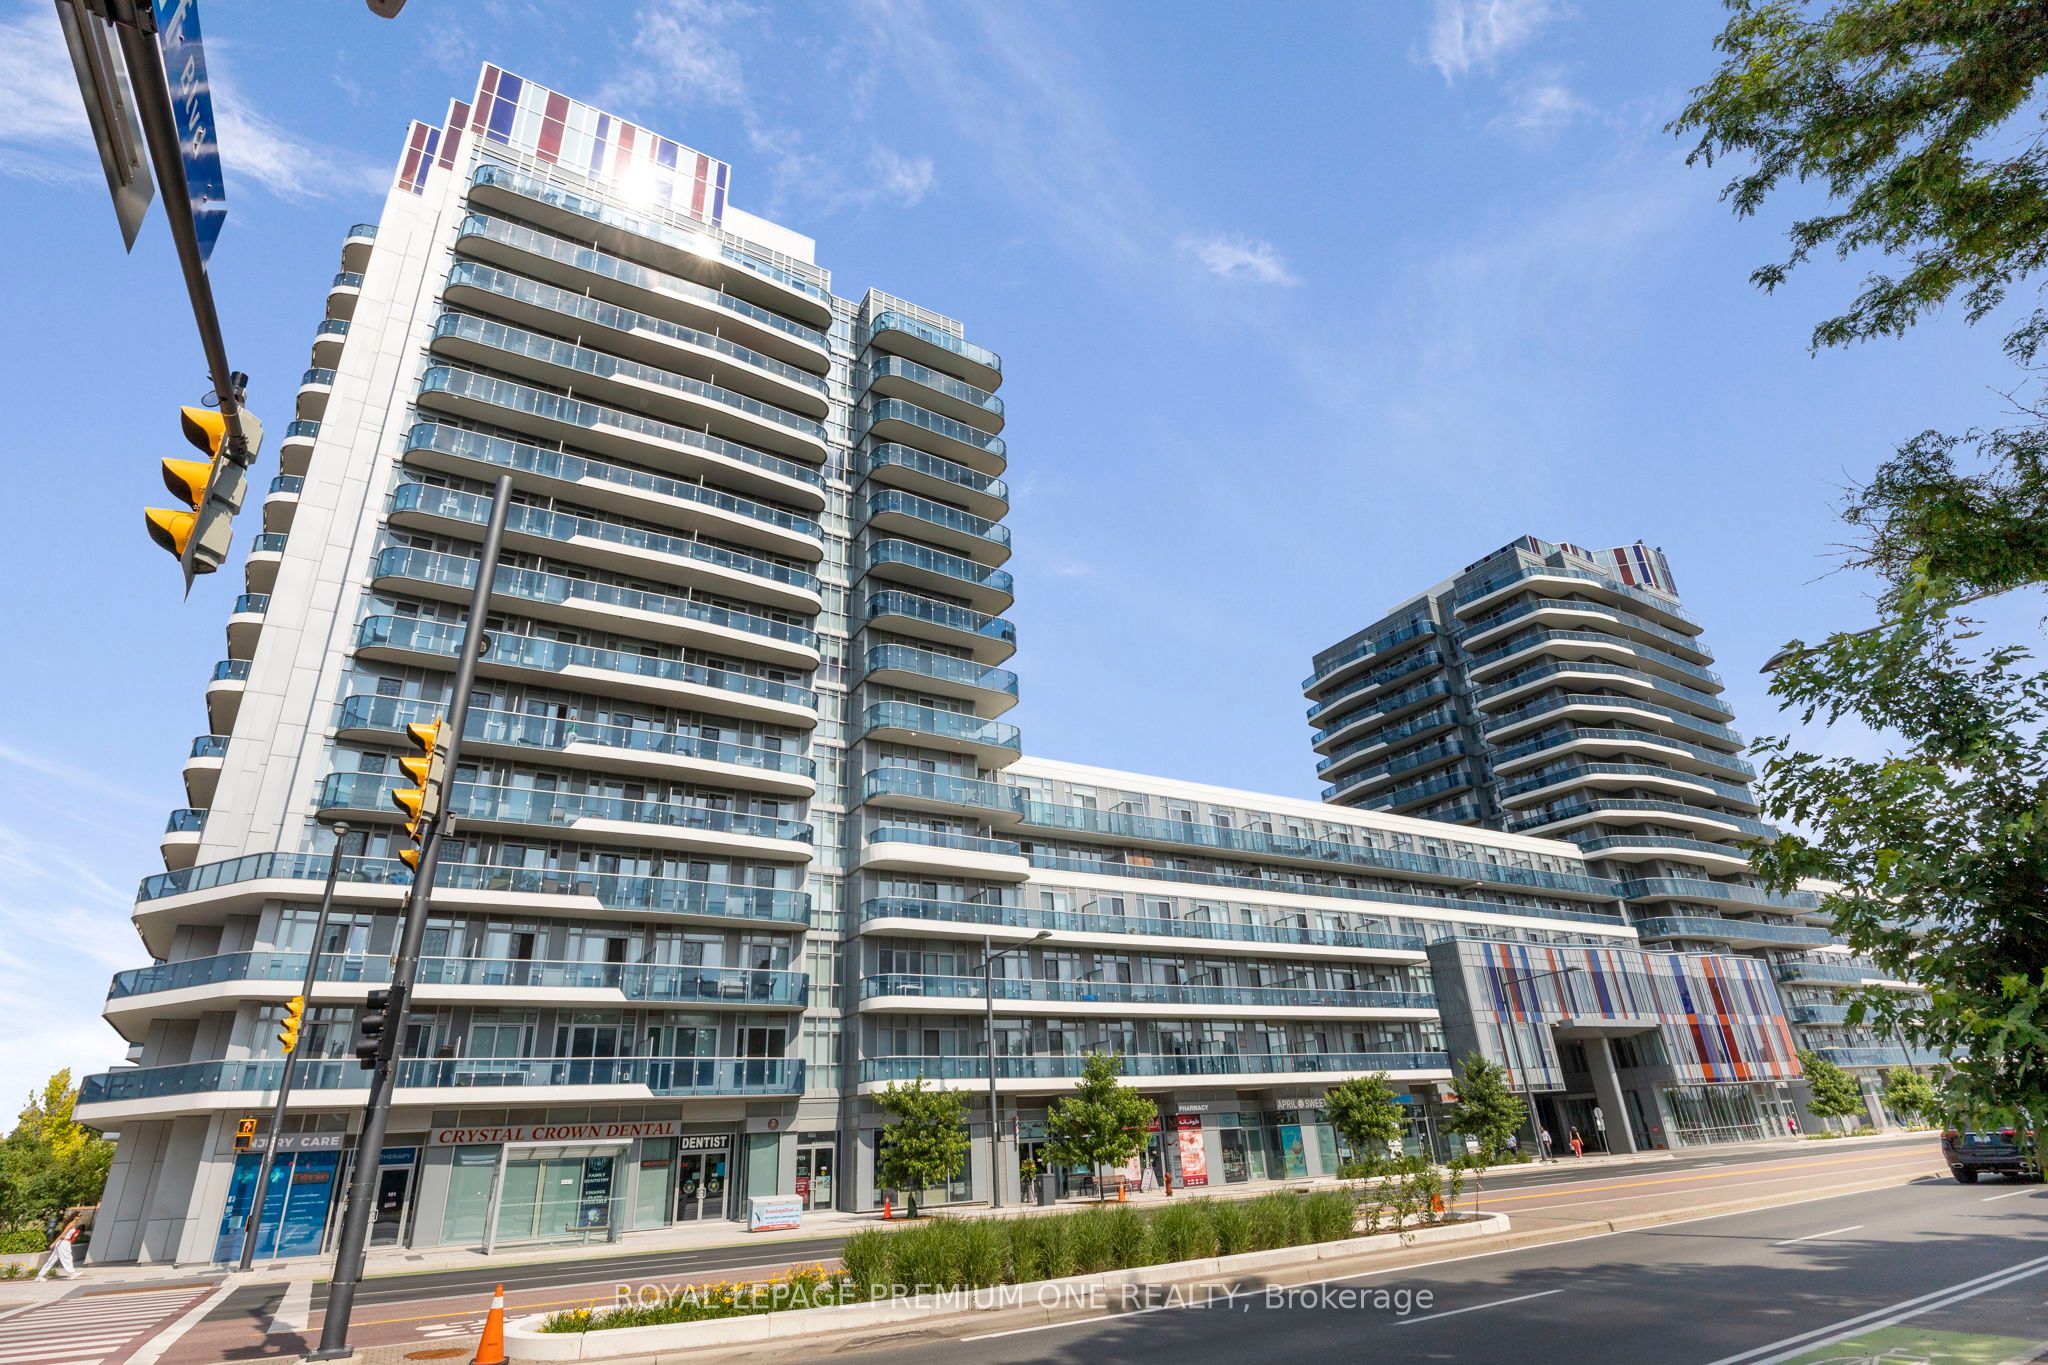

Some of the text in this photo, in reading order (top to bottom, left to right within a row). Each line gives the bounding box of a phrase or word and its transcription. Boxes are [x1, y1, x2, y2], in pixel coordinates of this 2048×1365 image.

[181, 54, 206, 160] Blvd
[1178, 1104, 1209, 1112] PHARMACY
[1277, 1099, 1298, 1110] APRIL
[439, 1122, 674, 1144] CRYSTAL CROWN DENTAL
[300, 1136, 340, 1147] CARE
[681, 1135, 728, 1149] DENTIST
